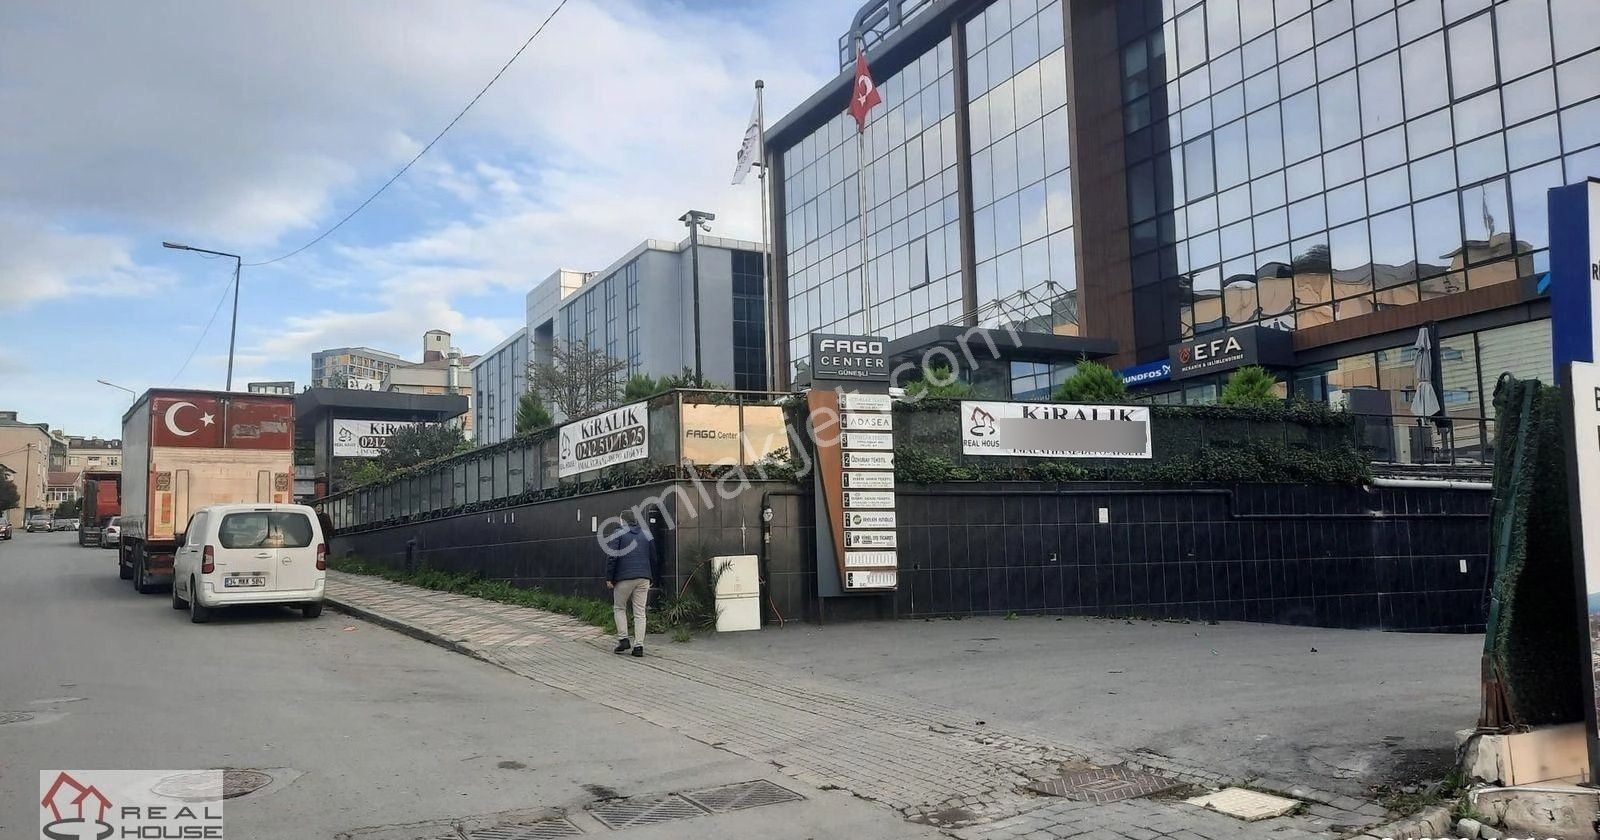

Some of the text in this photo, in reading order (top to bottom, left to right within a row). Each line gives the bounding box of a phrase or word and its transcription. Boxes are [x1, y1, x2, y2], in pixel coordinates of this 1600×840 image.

[1592, 260, 1600, 280] R
[820, 339, 883, 354] FAGO
[1194, 336, 1242, 360] EFA
[821, 356, 884, 368] CENTER
[686, 429, 738, 440] FAGO Center
[963, 439, 980, 447] REAL
